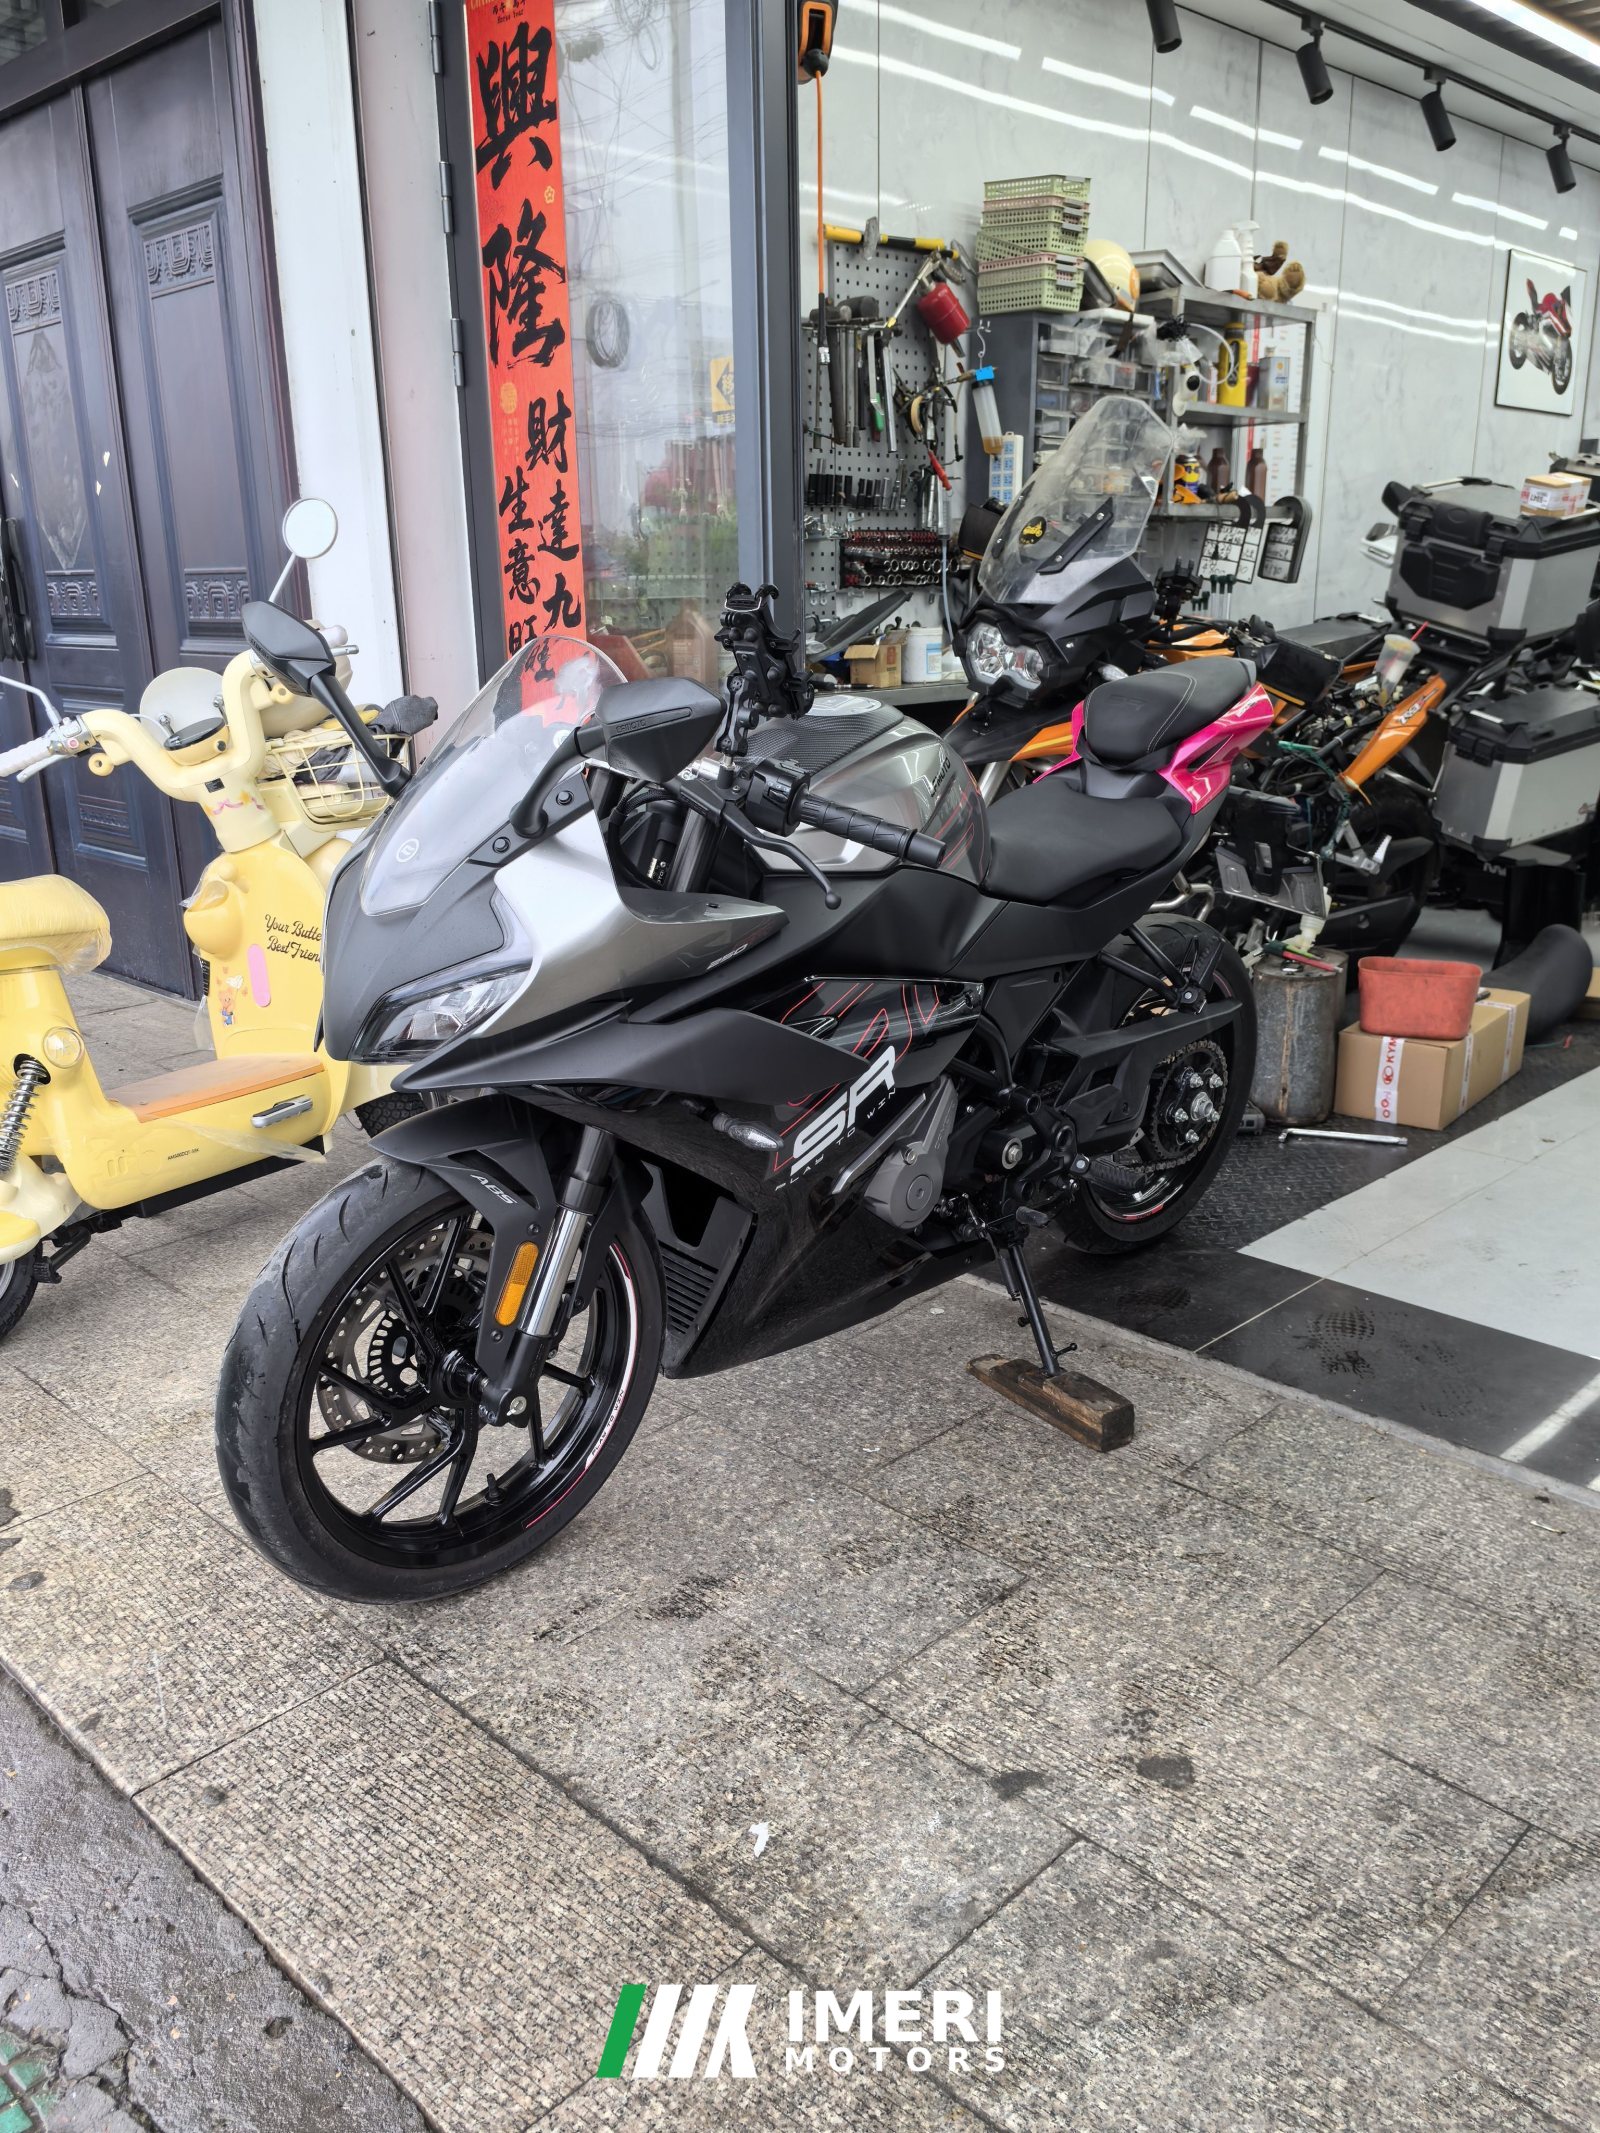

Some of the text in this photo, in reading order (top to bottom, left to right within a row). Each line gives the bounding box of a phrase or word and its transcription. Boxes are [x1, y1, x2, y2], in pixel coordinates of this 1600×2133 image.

[264, 913, 290, 934] Your
[267, 935, 290, 954] Best
[790, 1045, 896, 1177] SR
[774, 1087, 896, 1192] PLAY TO WIN
[469, 1173, 519, 1205] ABS
